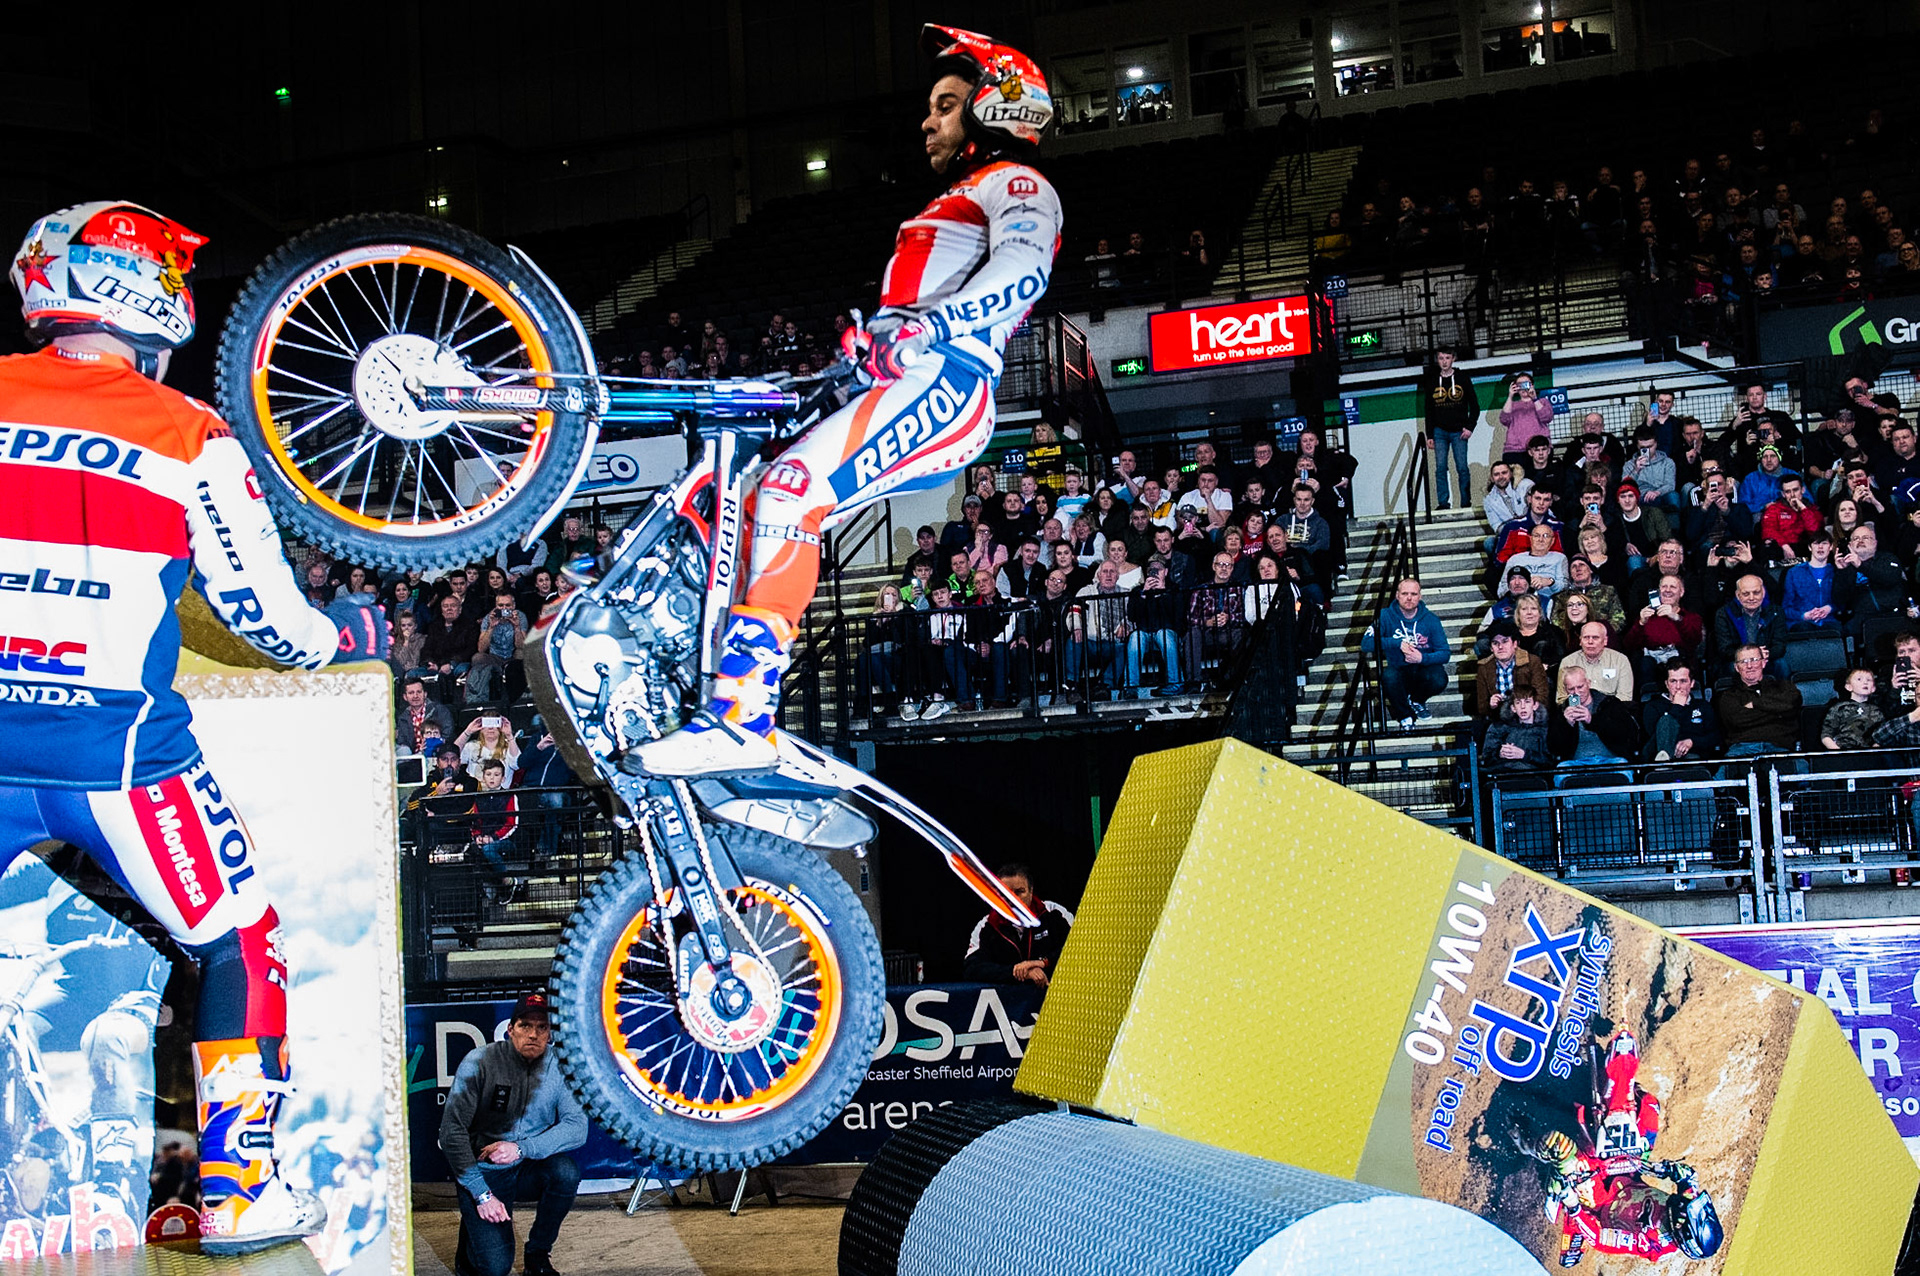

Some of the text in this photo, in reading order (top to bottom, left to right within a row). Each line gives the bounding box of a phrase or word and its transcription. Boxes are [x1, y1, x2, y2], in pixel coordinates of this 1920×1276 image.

[90, 251, 142, 275] SPEA
[1326, 279, 1346, 290] 210
[93, 275, 187, 339] hebo
[1190, 302, 1294, 350] heart
[1214, 351, 1227, 361] up
[1228, 349, 1244, 358] the
[1247, 345, 1264, 356] feel
[854, 375, 966, 490] REPSOL
[1283, 421, 1304, 434] 110
[583, 454, 640, 486] EO
[1005, 453, 1024, 464] 110
[196, 480, 244, 573] hebo
[714, 496, 737, 589] REPSOL
[0, 636, 87, 677] RC
[154, 804, 208, 908] Montesa
[1405, 880, 1497, 1066] 10W-40
[1549, 932, 1612, 1080] synthesis
[914, 1066, 974, 1080] Sheffield
[1424, 1024, 1482, 1153] off road
[843, 1100, 954, 1131] aren
